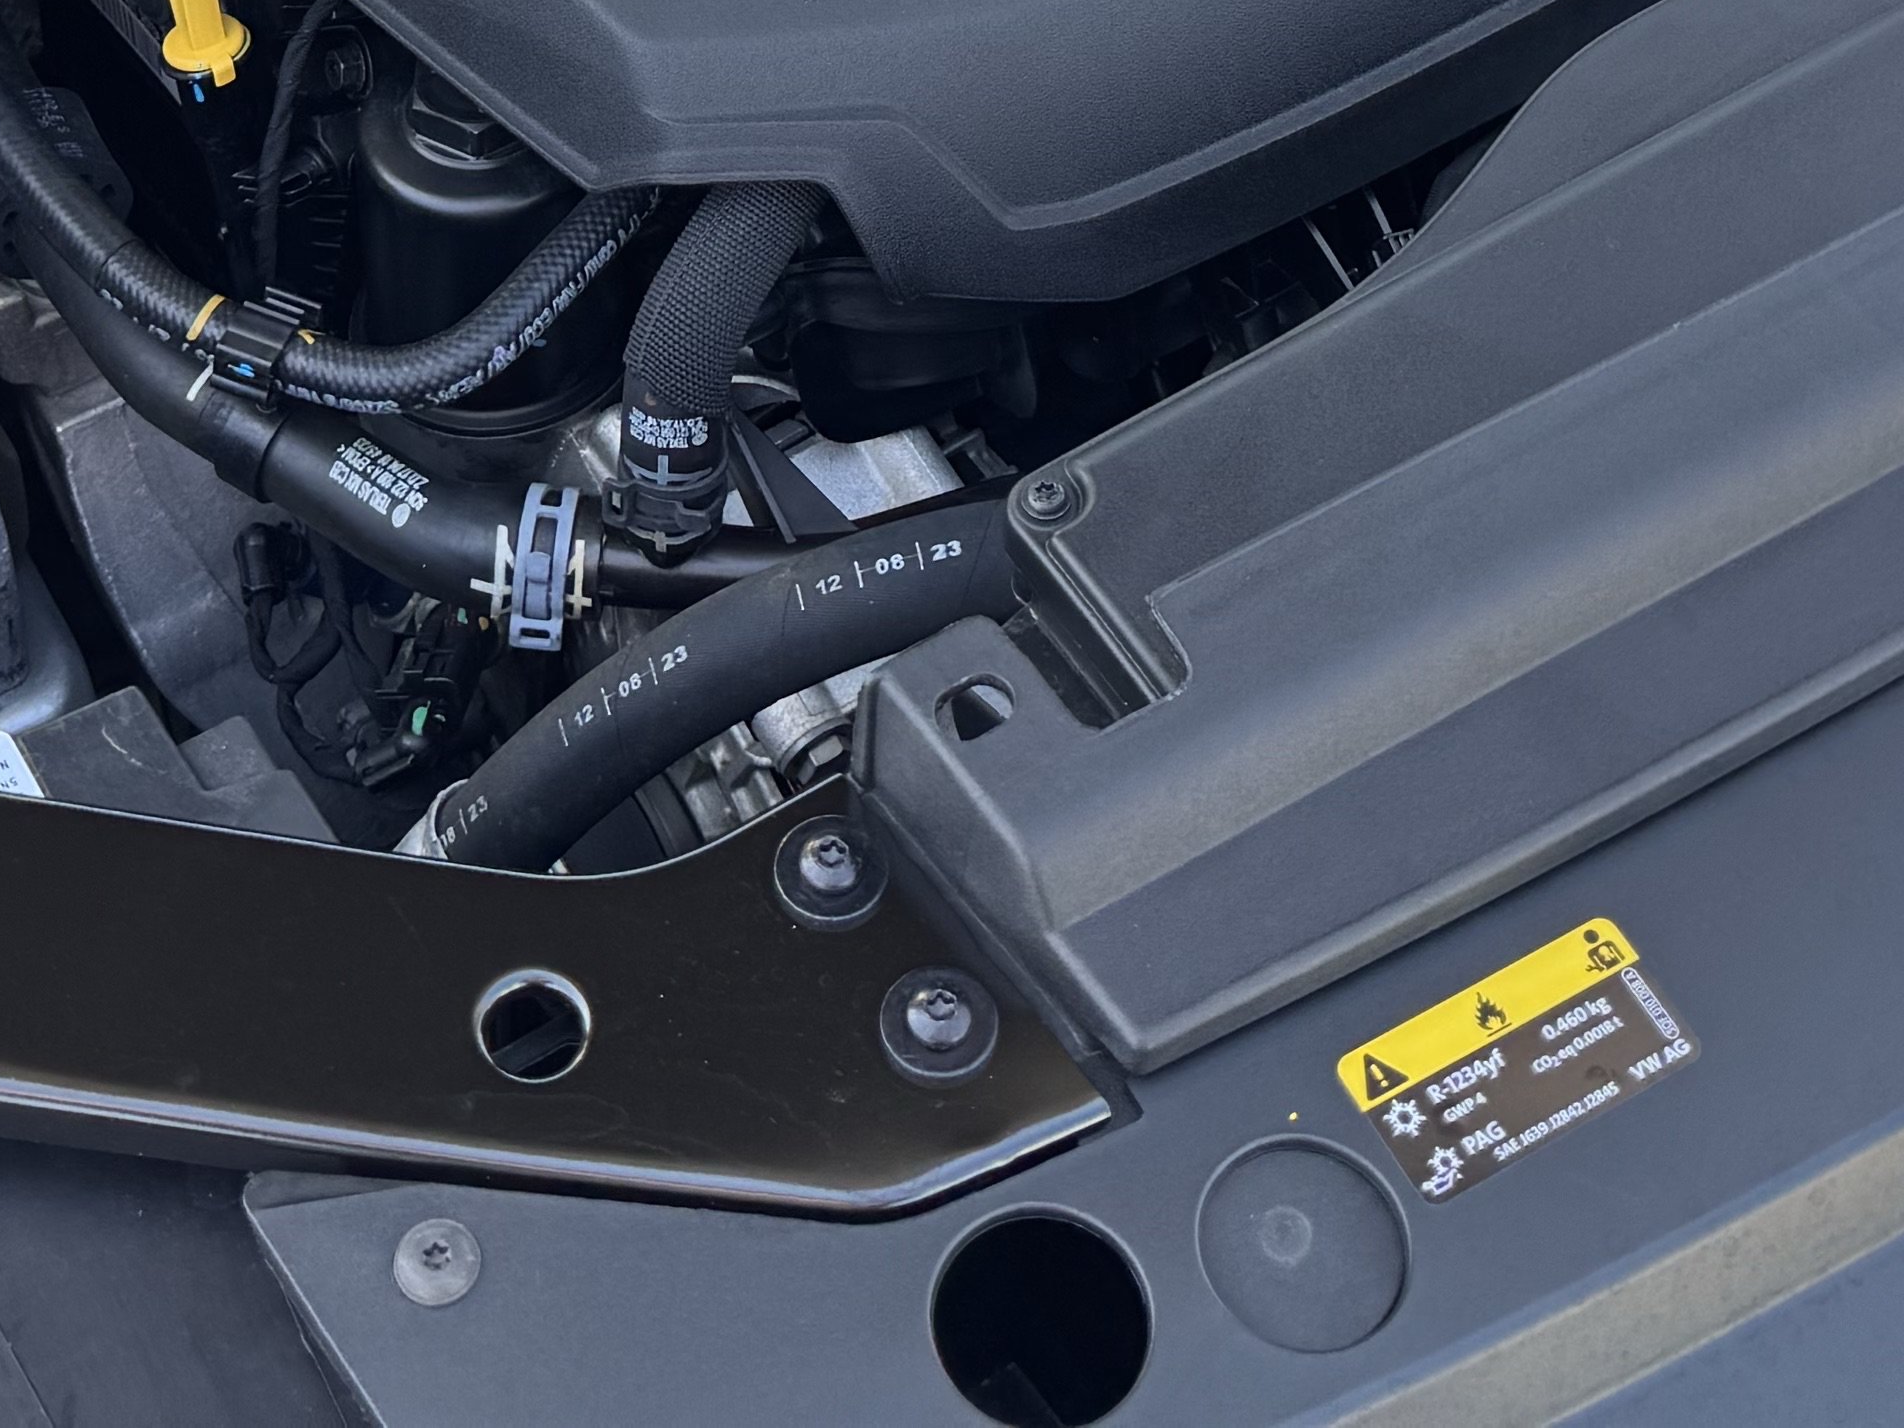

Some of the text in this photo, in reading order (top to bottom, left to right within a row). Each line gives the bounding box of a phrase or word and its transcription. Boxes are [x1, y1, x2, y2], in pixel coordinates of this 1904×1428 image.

[815, 540, 963, 596] 12 08 23
[573, 704, 596, 728] 12
[660, 645, 690, 674] 23
[467, 796, 489, 823] 23
[1539, 993, 1613, 1041] 0.460 kg
[1423, 1046, 1509, 1107] R-1234yf
[1627, 1036, 1692, 1081] VW AG
[1441, 1097, 1478, 1124] GWP
[1492, 1080, 1620, 1161] SAE J639 J2842 J2845
[1459, 1120, 1506, 1156] PAG
